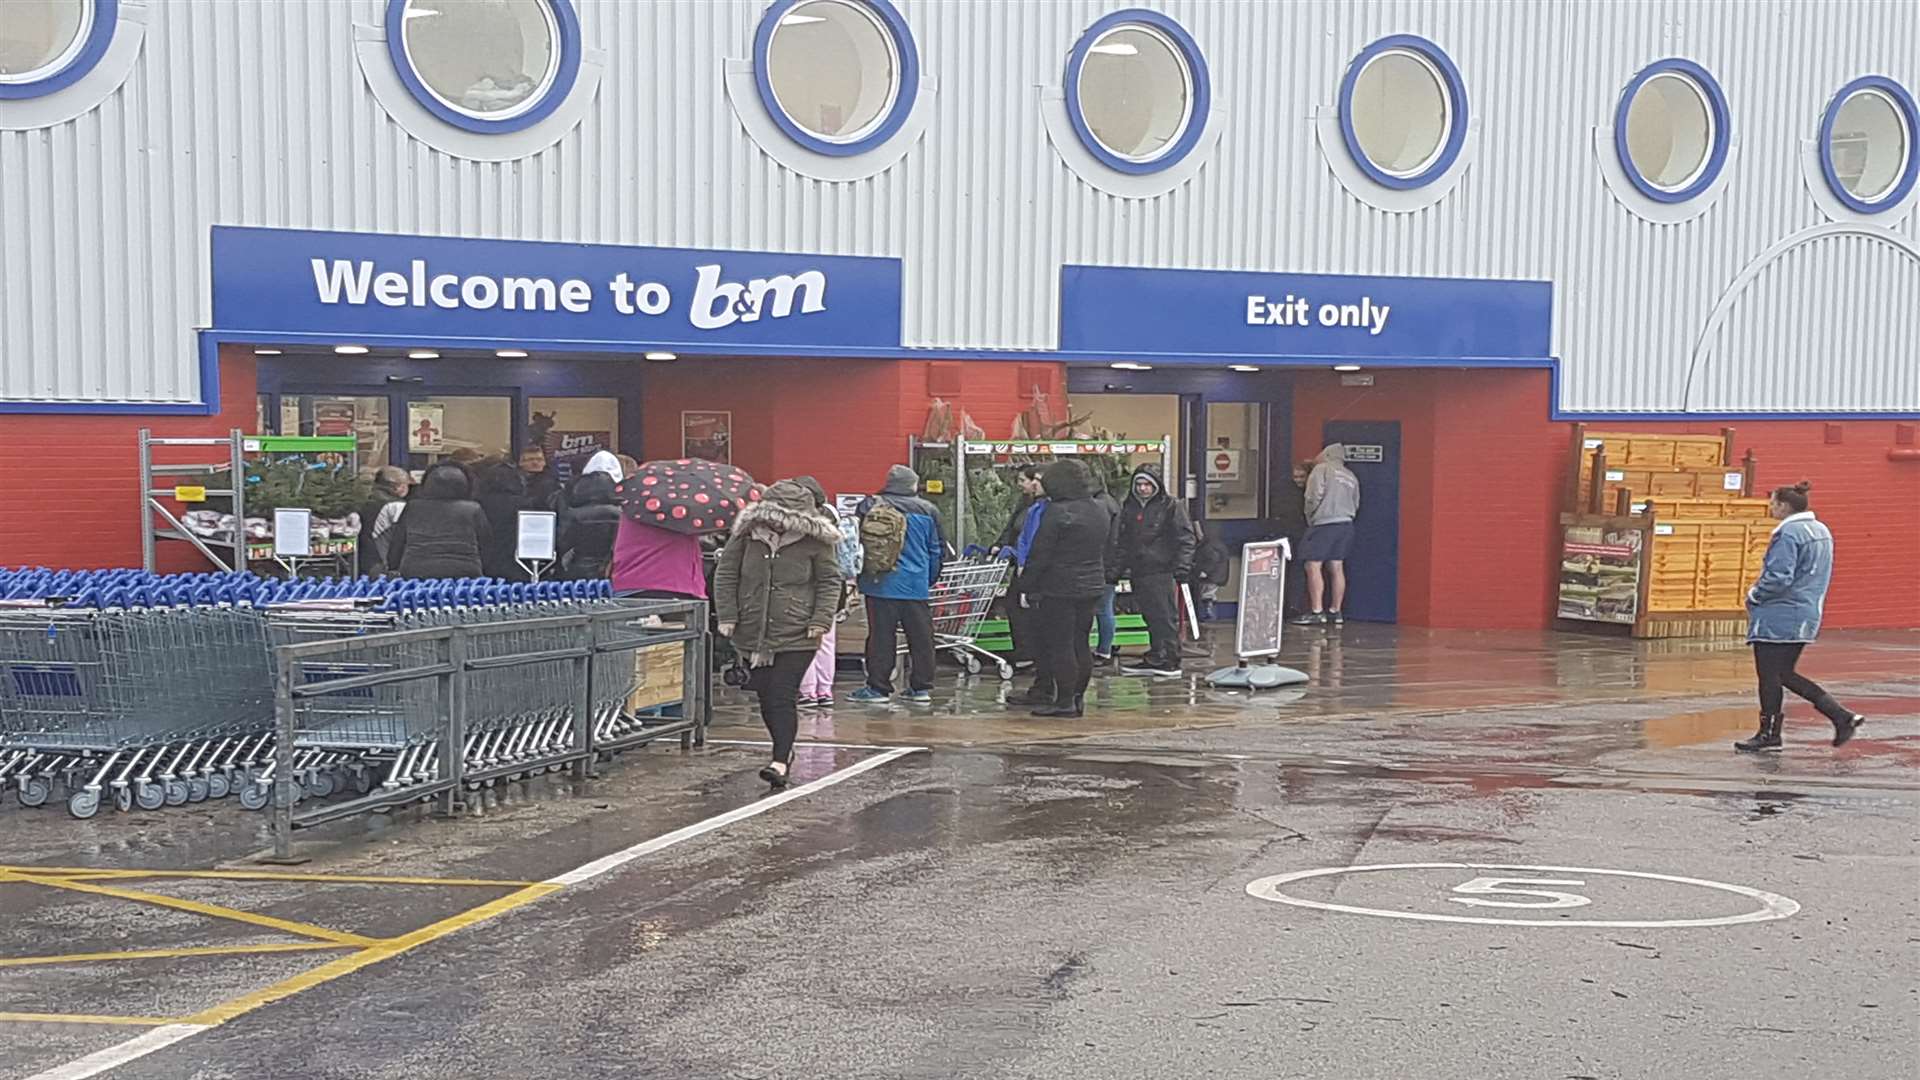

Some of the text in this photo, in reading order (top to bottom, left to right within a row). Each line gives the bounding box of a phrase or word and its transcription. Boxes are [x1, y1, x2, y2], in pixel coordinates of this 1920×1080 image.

[311, 259, 827, 329] Welcome to b&m
[1247, 295, 1390, 335] Exit only
[1448, 877, 1592, 908] 5
